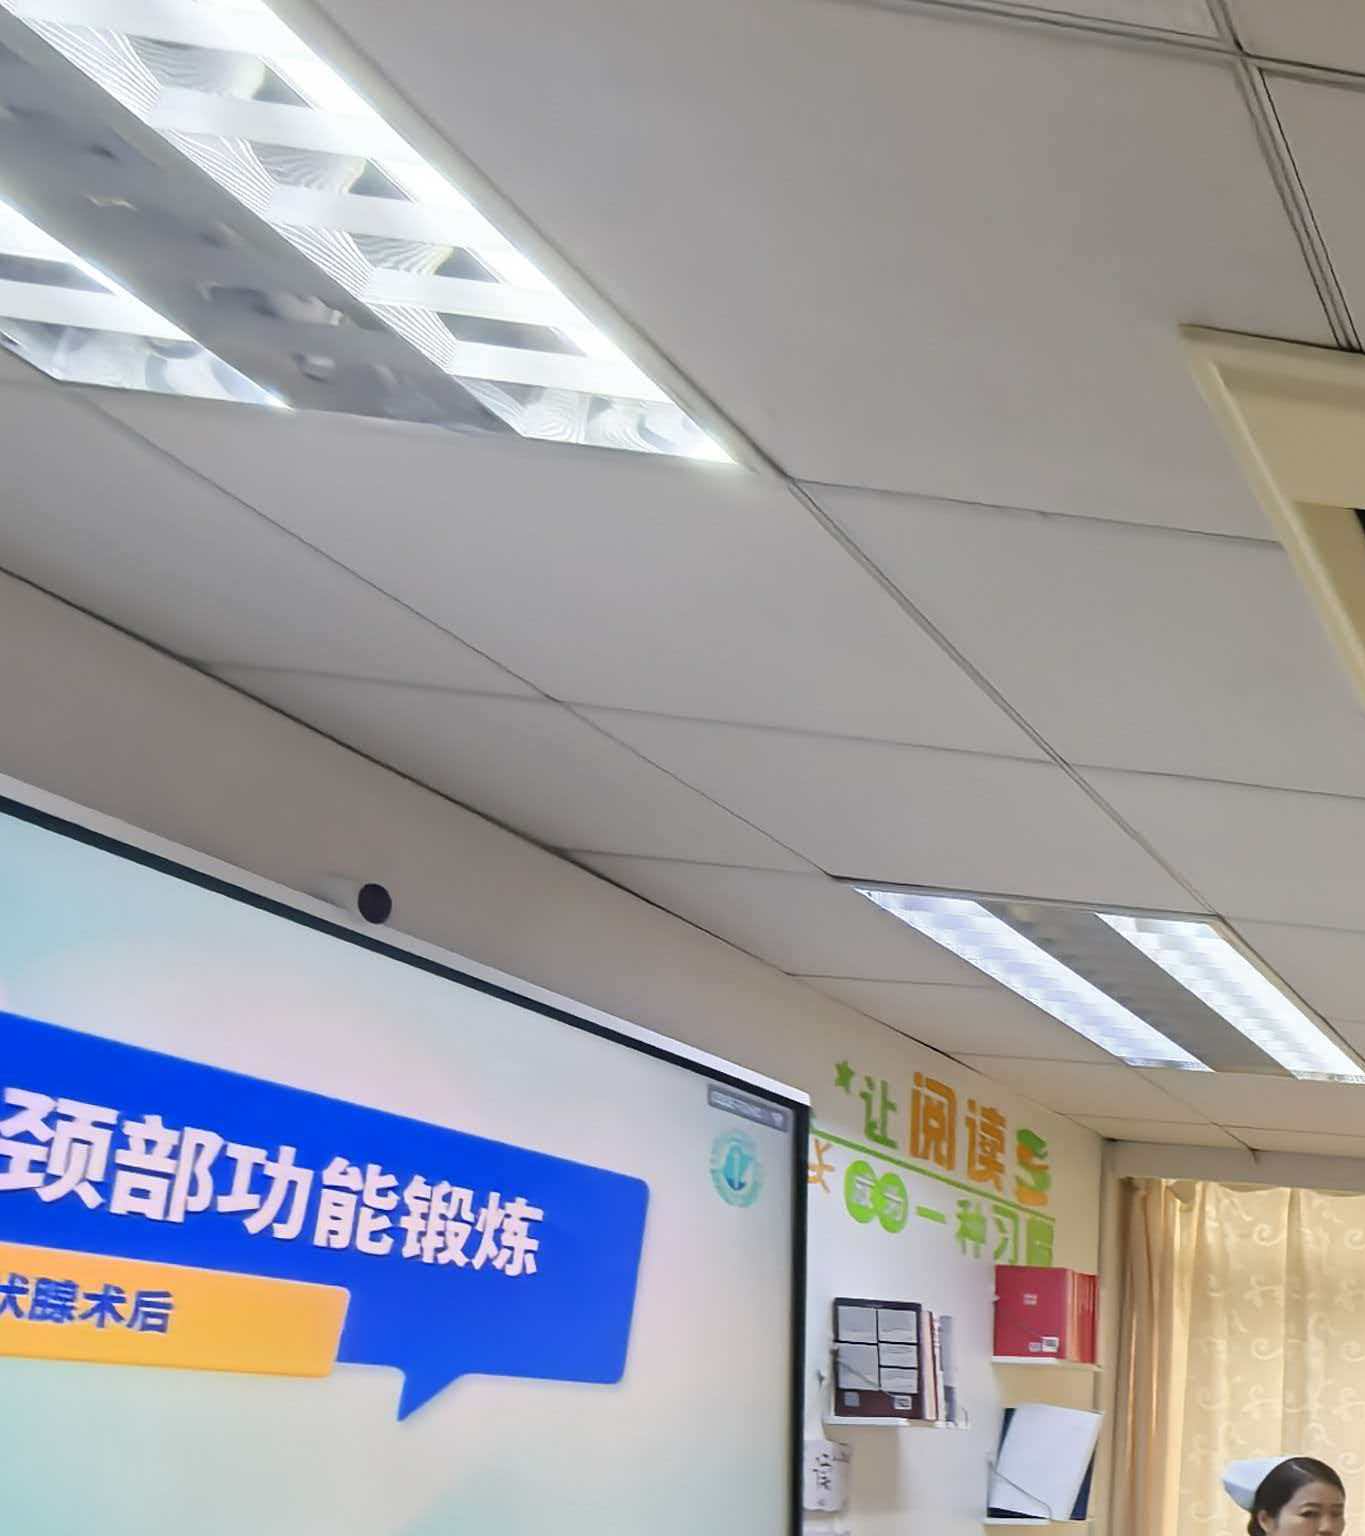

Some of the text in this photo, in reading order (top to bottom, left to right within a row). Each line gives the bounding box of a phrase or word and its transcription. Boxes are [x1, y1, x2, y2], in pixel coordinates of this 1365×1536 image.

[0, 1087, 544, 1276] 颈部功能锻炼
[860, 1072, 1007, 1193] 让阅读
